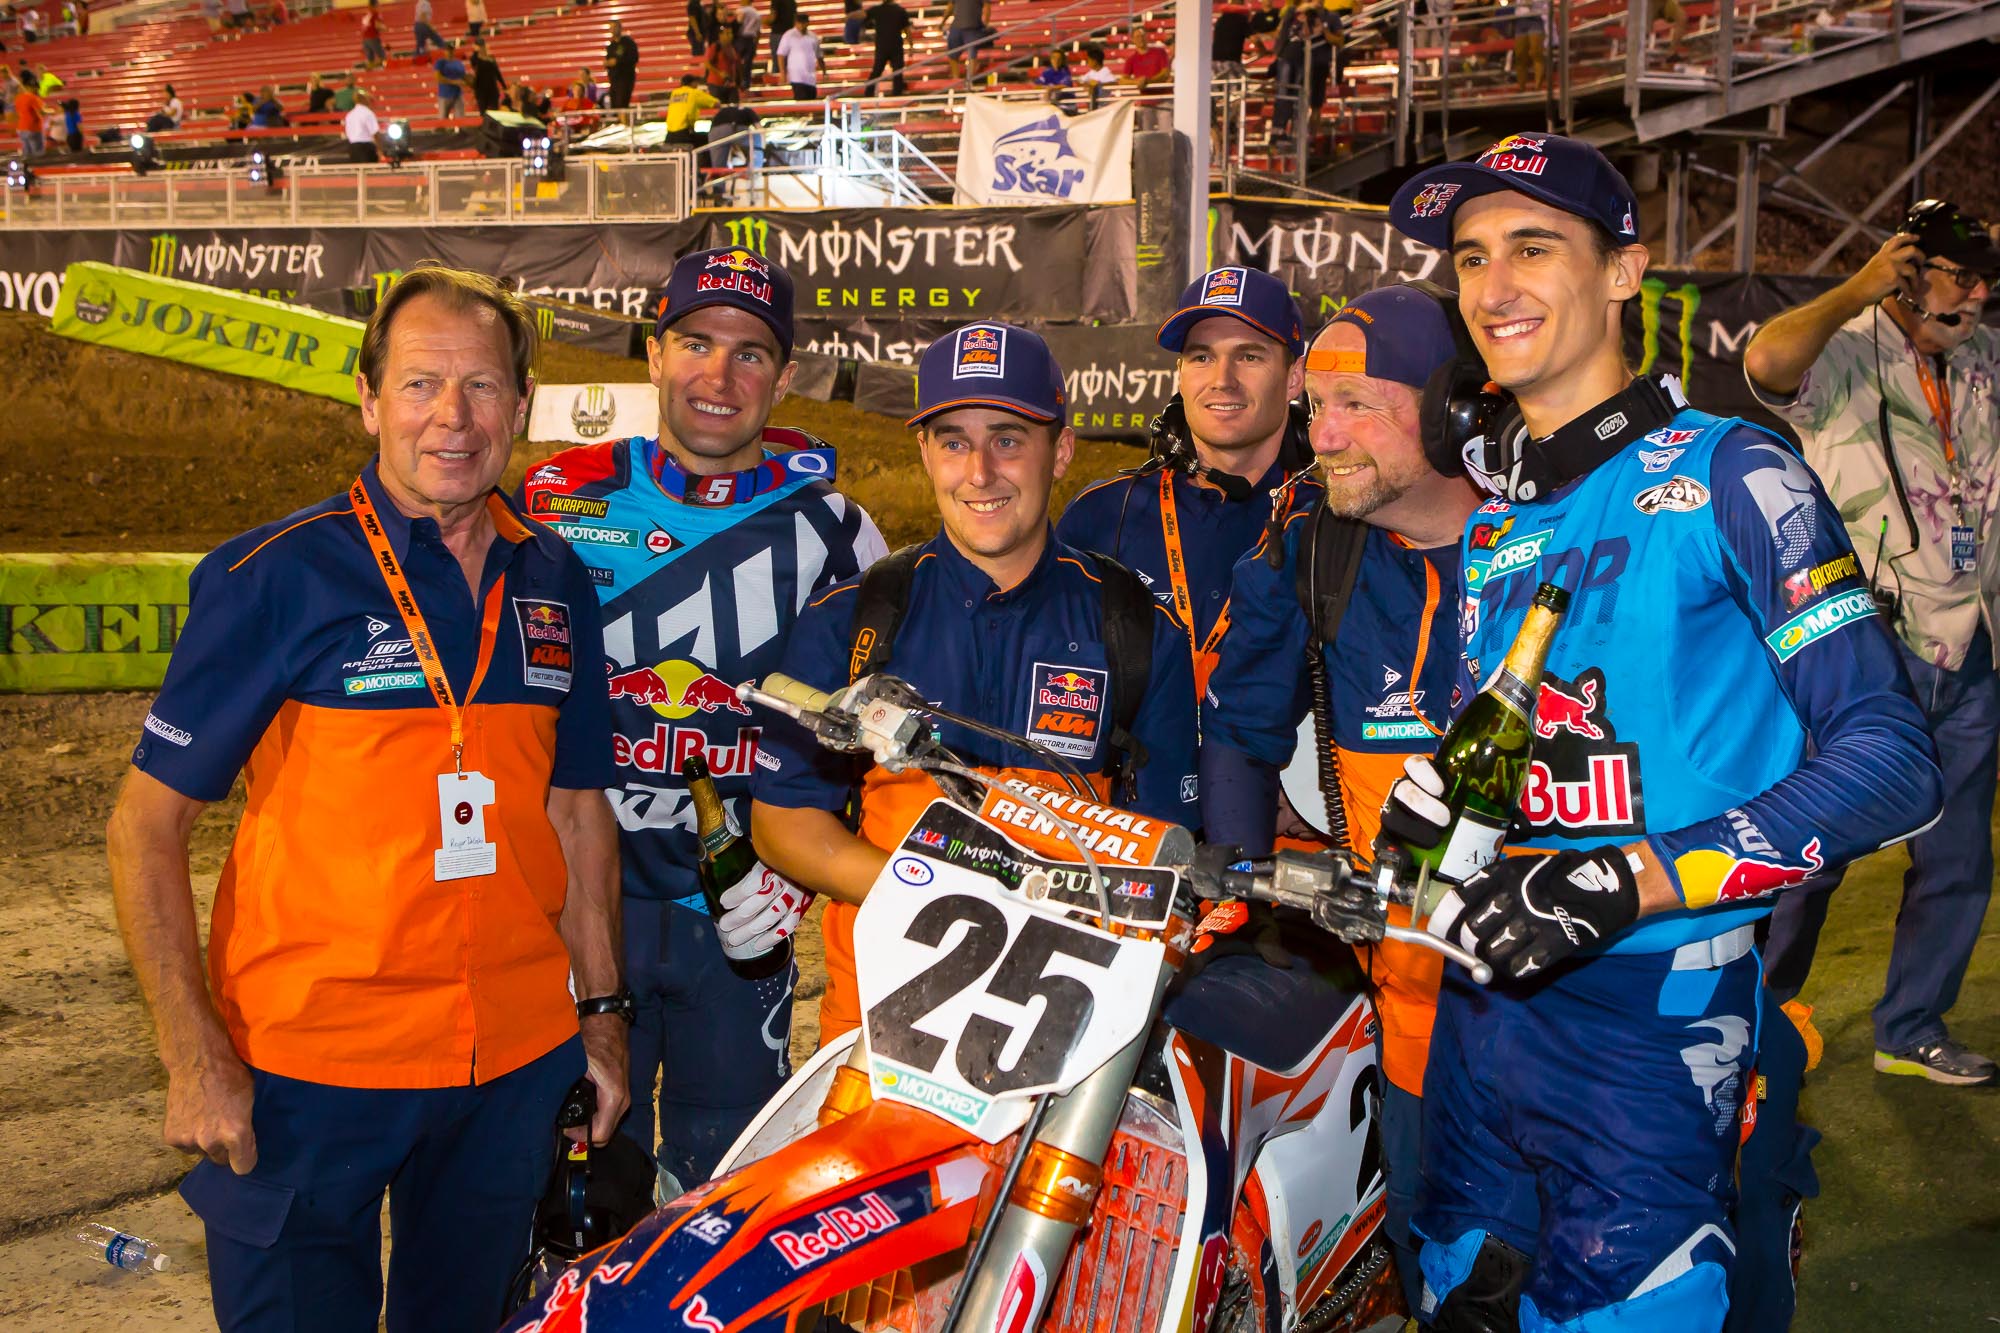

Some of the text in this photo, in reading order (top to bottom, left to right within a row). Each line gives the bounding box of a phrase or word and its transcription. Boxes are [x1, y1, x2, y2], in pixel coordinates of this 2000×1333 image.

[992, 154, 1085, 197] Star
[179, 238, 324, 279] MONSTER
[779, 219, 1023, 276] MONSTER
[1228, 217, 1442, 283] MONS
[697, 272, 774, 306] Red Bull
[816, 288, 981, 307] ENERGY
[1354, 308, 1375, 325] WINGS
[121, 297, 321, 367] JOKER
[527, 478, 569, 487] RENTHAL
[705, 479, 733, 503] 5
[557, 525, 631, 545] MOTOREX
[380, 550, 399, 577] KTM
[398, 590, 418, 617] KTM
[527, 623, 570, 643] Red Bull
[342, 657, 396, 669] RACING
[357, 661, 422, 673] SYSTEMS
[530, 644, 570, 668] KTM
[366, 674, 419, 690] MOTOREX
[433, 675, 452, 706] KTM
[1039, 688, 1099, 712] Red Bull
[147, 714, 193, 741] ENTHAL
[1035, 710, 1096, 737] KTM
[1377, 723, 1432, 738] MOTOREX
[612, 722, 764, 778] ed Bull
[1067, 742, 1093, 753] RACING
[1521, 753, 1635, 828] Bull
[1005, 778, 1151, 838] RENTHAL
[909, 828, 949, 850] AMA
[989, 798, 1141, 865] RENTHAL
[1047, 867, 1111, 895] CUP
[1113, 880, 1156, 899] AMA
[867, 893, 1122, 1097] 25
[897, 1072, 984, 1119] MOTOREX
[769, 1192, 901, 1270] Red Bull
